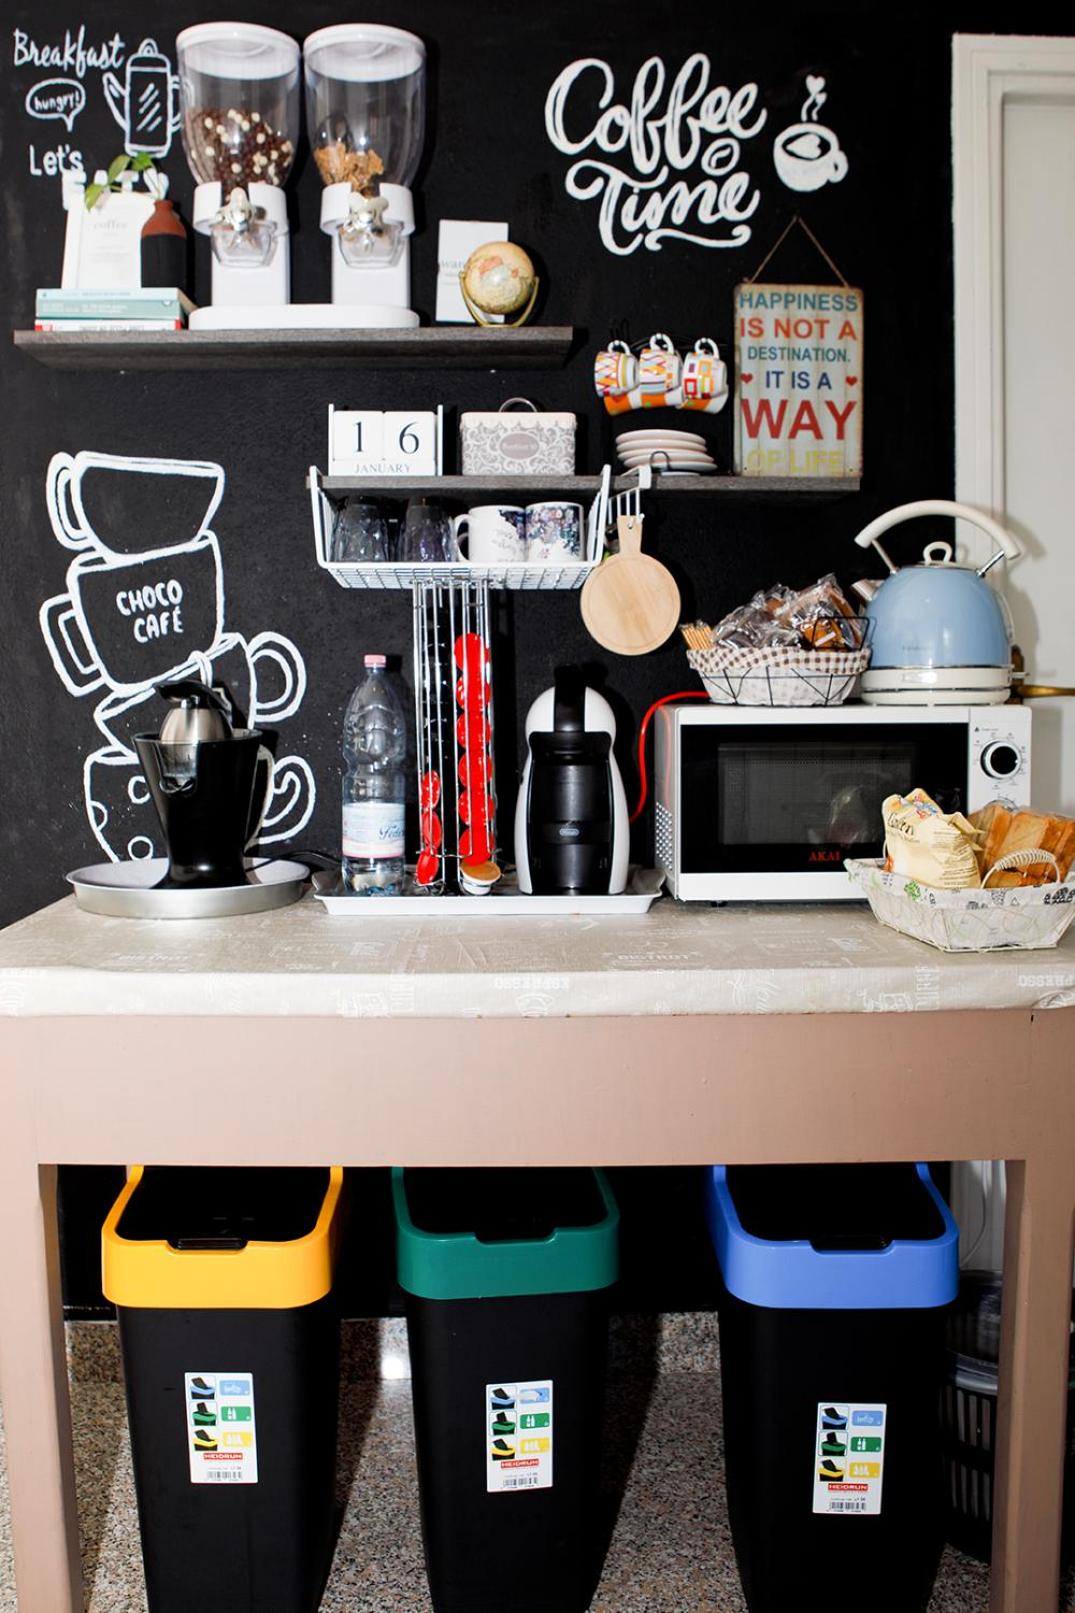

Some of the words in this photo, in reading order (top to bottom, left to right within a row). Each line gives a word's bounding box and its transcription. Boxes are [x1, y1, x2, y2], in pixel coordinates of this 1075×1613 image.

[13, 24, 125, 77] Breakfast
[544, 52, 767, 174] Coffee
[29, 145, 84, 175] Let's
[565, 159, 760, 256] Time
[739, 292, 858, 312] HAPPINESS
[740, 318, 764, 338] IS
[774, 319, 830, 340] NOT
[838, 319, 857, 341] A
[765, 371, 785, 389] IT
[791, 371, 810, 390] IS
[817, 372, 832, 390] A
[741, 399, 857, 440] WAY
[354, 463, 412, 474] JANUARY
[746, 449, 782, 470] OF
[790, 450, 844, 473] LIFE
[116, 579, 183, 616] CHOCO
[808, 850, 841, 861] AKAI
